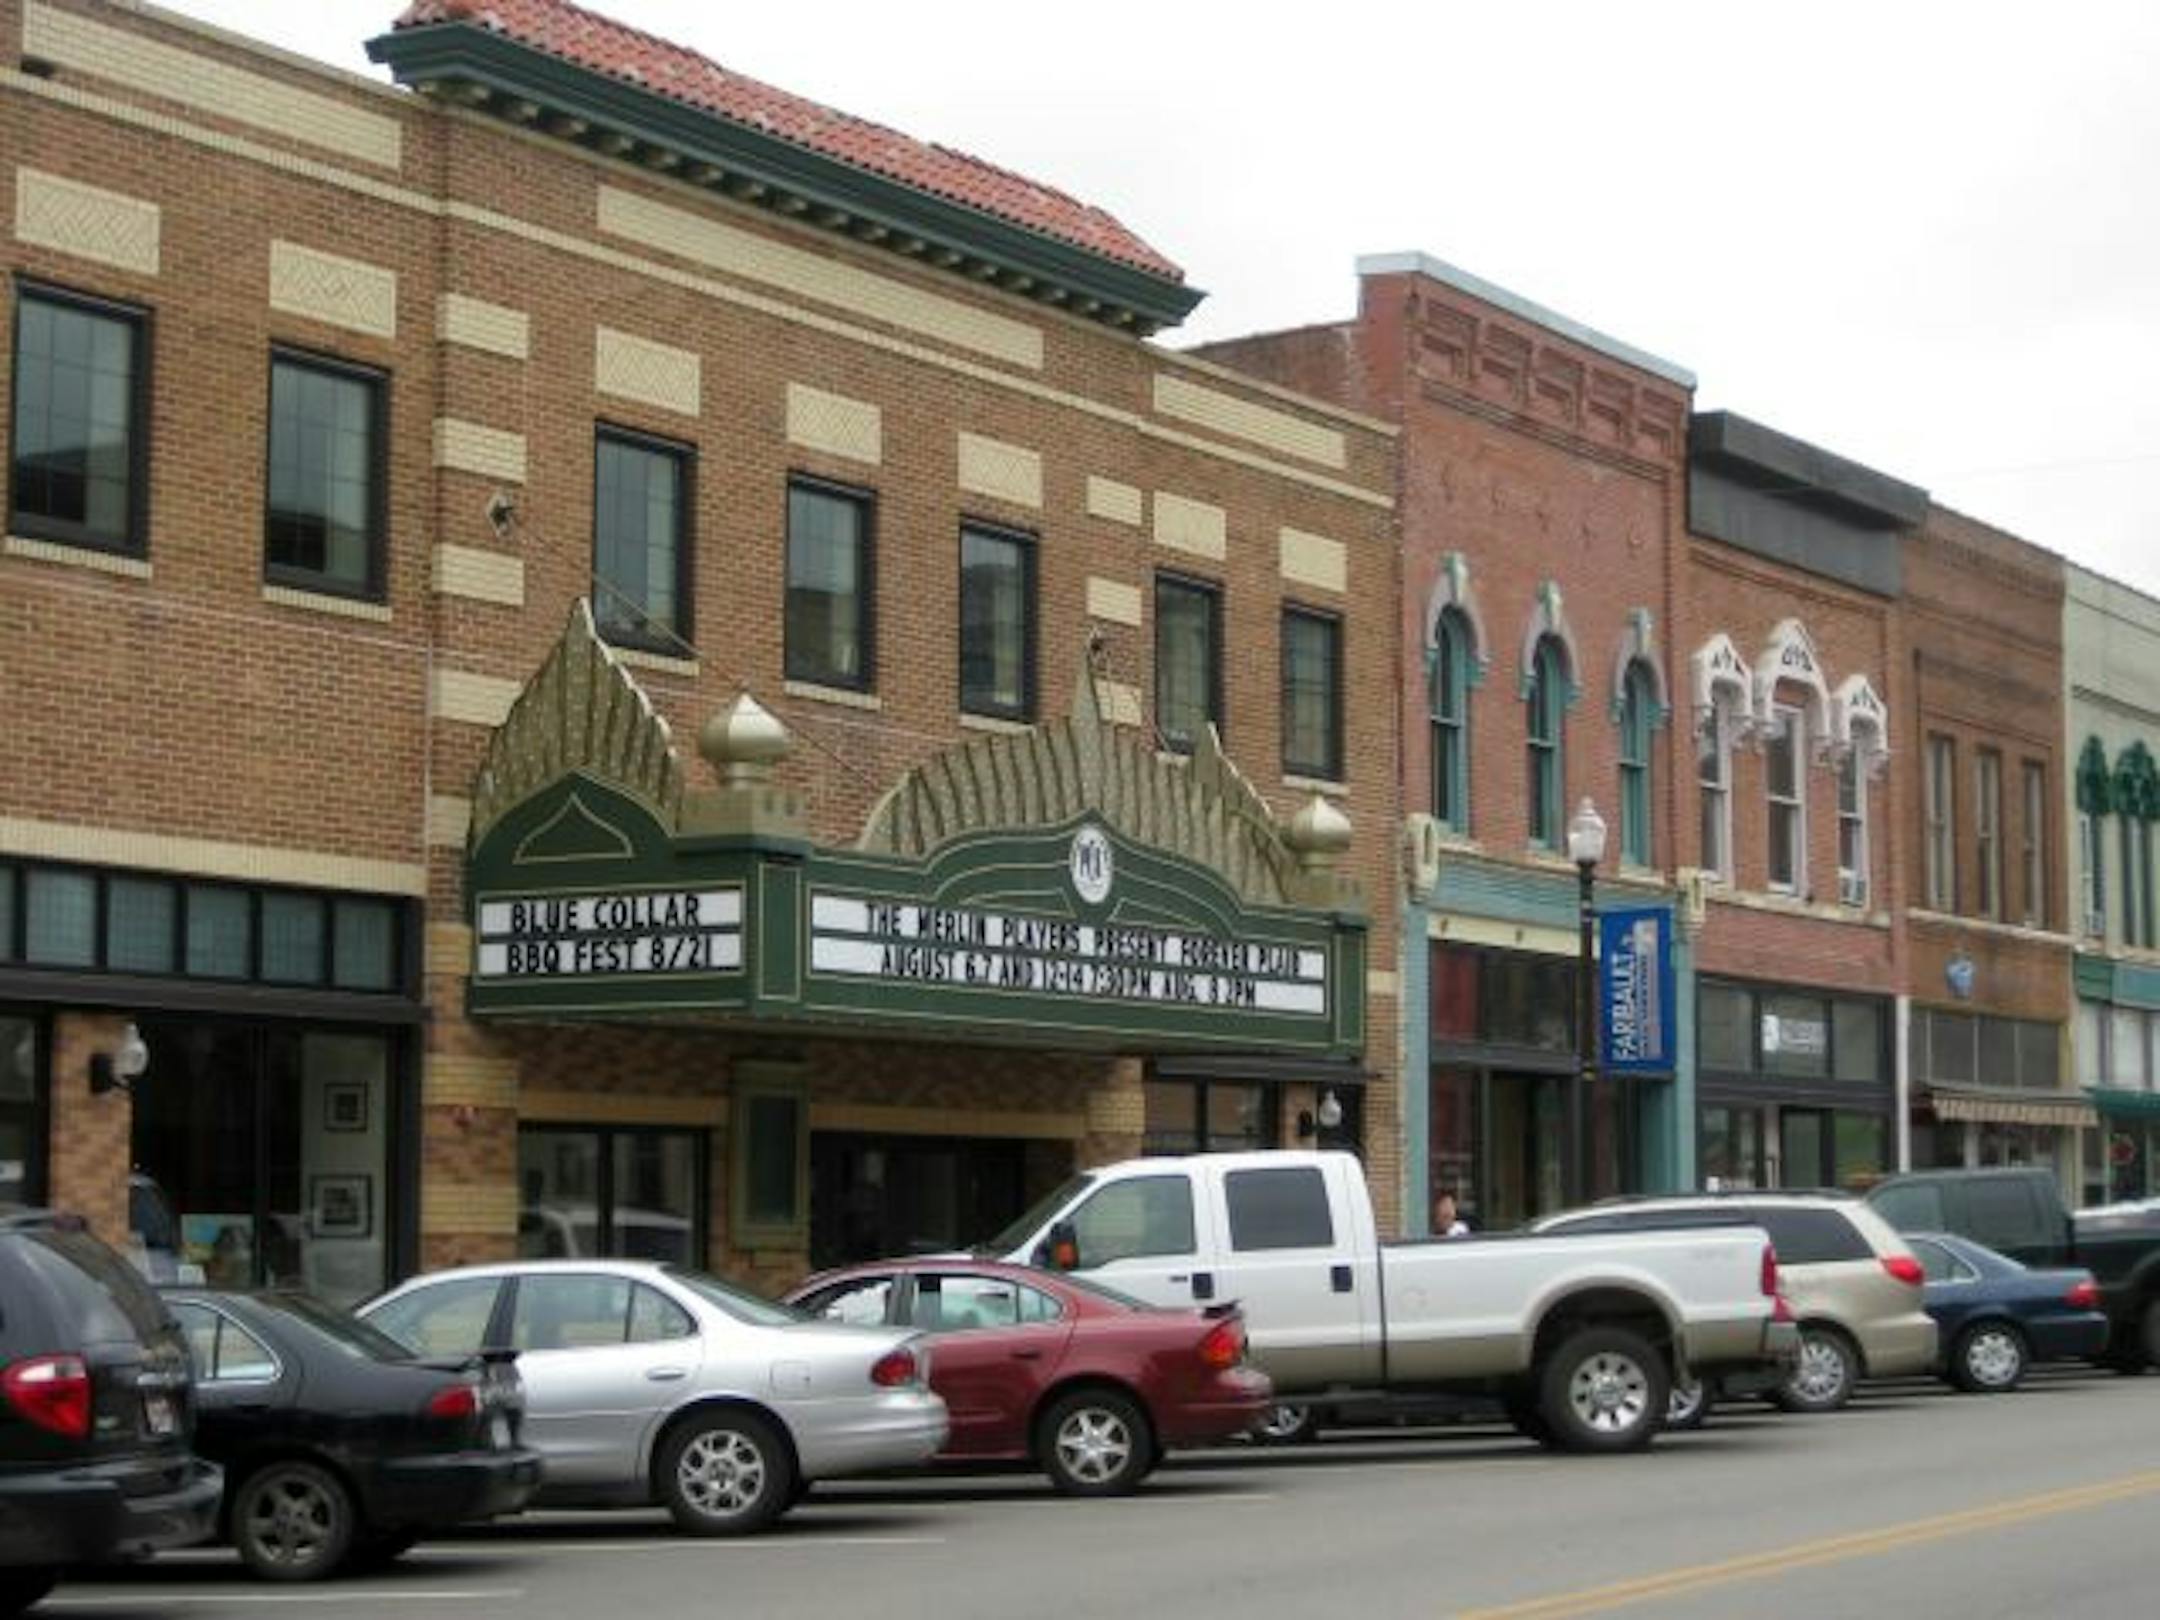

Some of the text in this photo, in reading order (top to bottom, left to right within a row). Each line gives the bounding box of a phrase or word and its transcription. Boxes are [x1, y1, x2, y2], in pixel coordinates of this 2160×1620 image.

[512, 894, 700, 933] BLUE COLLAR
[508, 933, 711, 973] BBQ FEST 8/21
[867, 902, 1299, 980] THE MERLIN PLAYERS PRESENT FOREVER PLAID
[881, 946, 952, 979] AUGUST
[1001, 954, 1033, 988] AND
